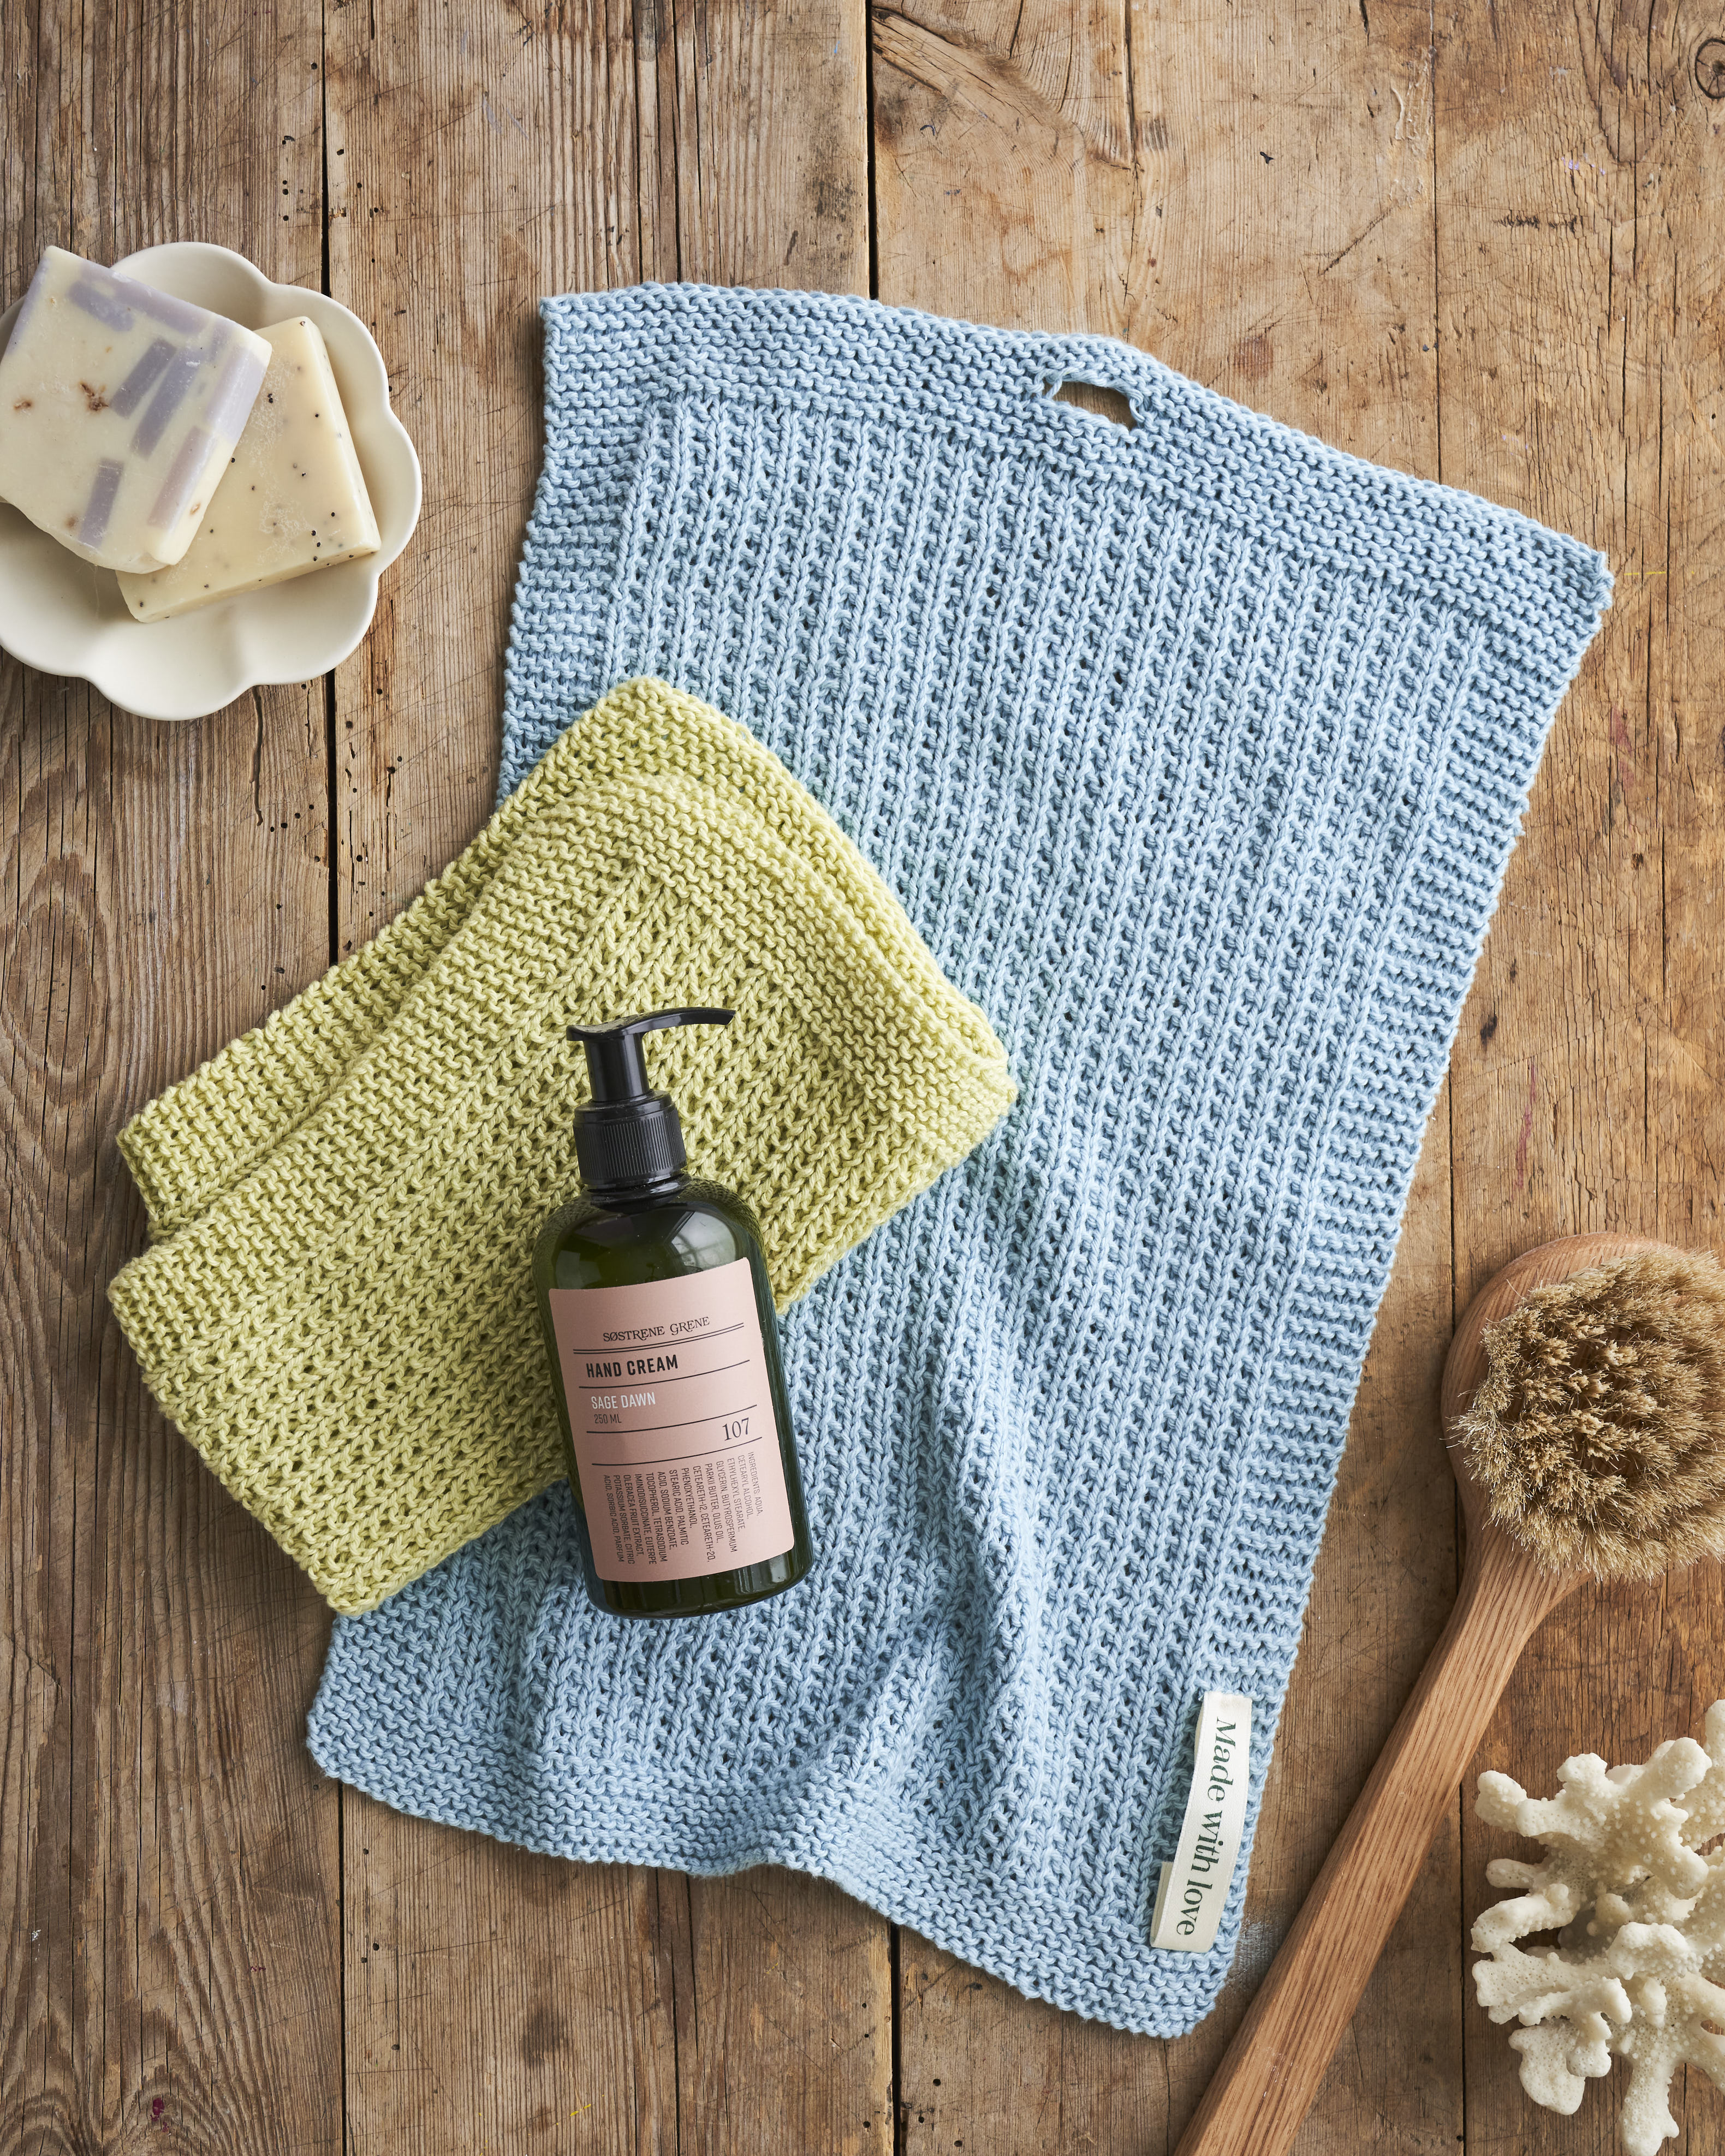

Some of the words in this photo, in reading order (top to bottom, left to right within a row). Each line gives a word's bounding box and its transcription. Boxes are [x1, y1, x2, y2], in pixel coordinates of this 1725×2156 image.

[603, 1326, 665, 1342] SØSTRENE
[670, 1317, 710, 1335] GRENE
[586, 1362, 622, 1378] HAND
[627, 1355, 678, 1375] CREAM
[591, 1396, 618, 1409] SAGE
[621, 1392, 656, 1408] DAWN
[594, 1414, 609, 1424] 250
[610, 1413, 622, 1424] ML
[722, 1418, 750, 1440] 107
[727, 1458, 740, 1498] ETHYLHEXYL
[738, 1455, 748, 1487] CETEARYL
[623, 1475, 635, 1507] OLERACEA
[629, 1509, 639, 1526] FRUIT
[661, 1490, 672, 1515] SODIUM
[669, 1469, 681, 1496] STEARIC
[677, 1516, 689, 1545] PALMITIC
[705, 1463, 715, 1485] PARKII
[713, 1513, 722, 1529] OLUS
[607, 1493, 616, 1516] SORBIC
[614, 1536, 624, 1562] PARFUM
[614, 1475, 626, 1511] POTASSIUM
[625, 1544, 635, 1564] CITRIC
[653, 1517, 668, 1562] TETRASODIUM
[722, 1494, 737, 1552] BUTYROSPERMUM
[645, 1537, 657, 1564] EUTERPE
[1208, 1717, 1236, 1802] Made
[1191, 1810, 1223, 1873] with
[1176, 1879, 1212, 1935] love
